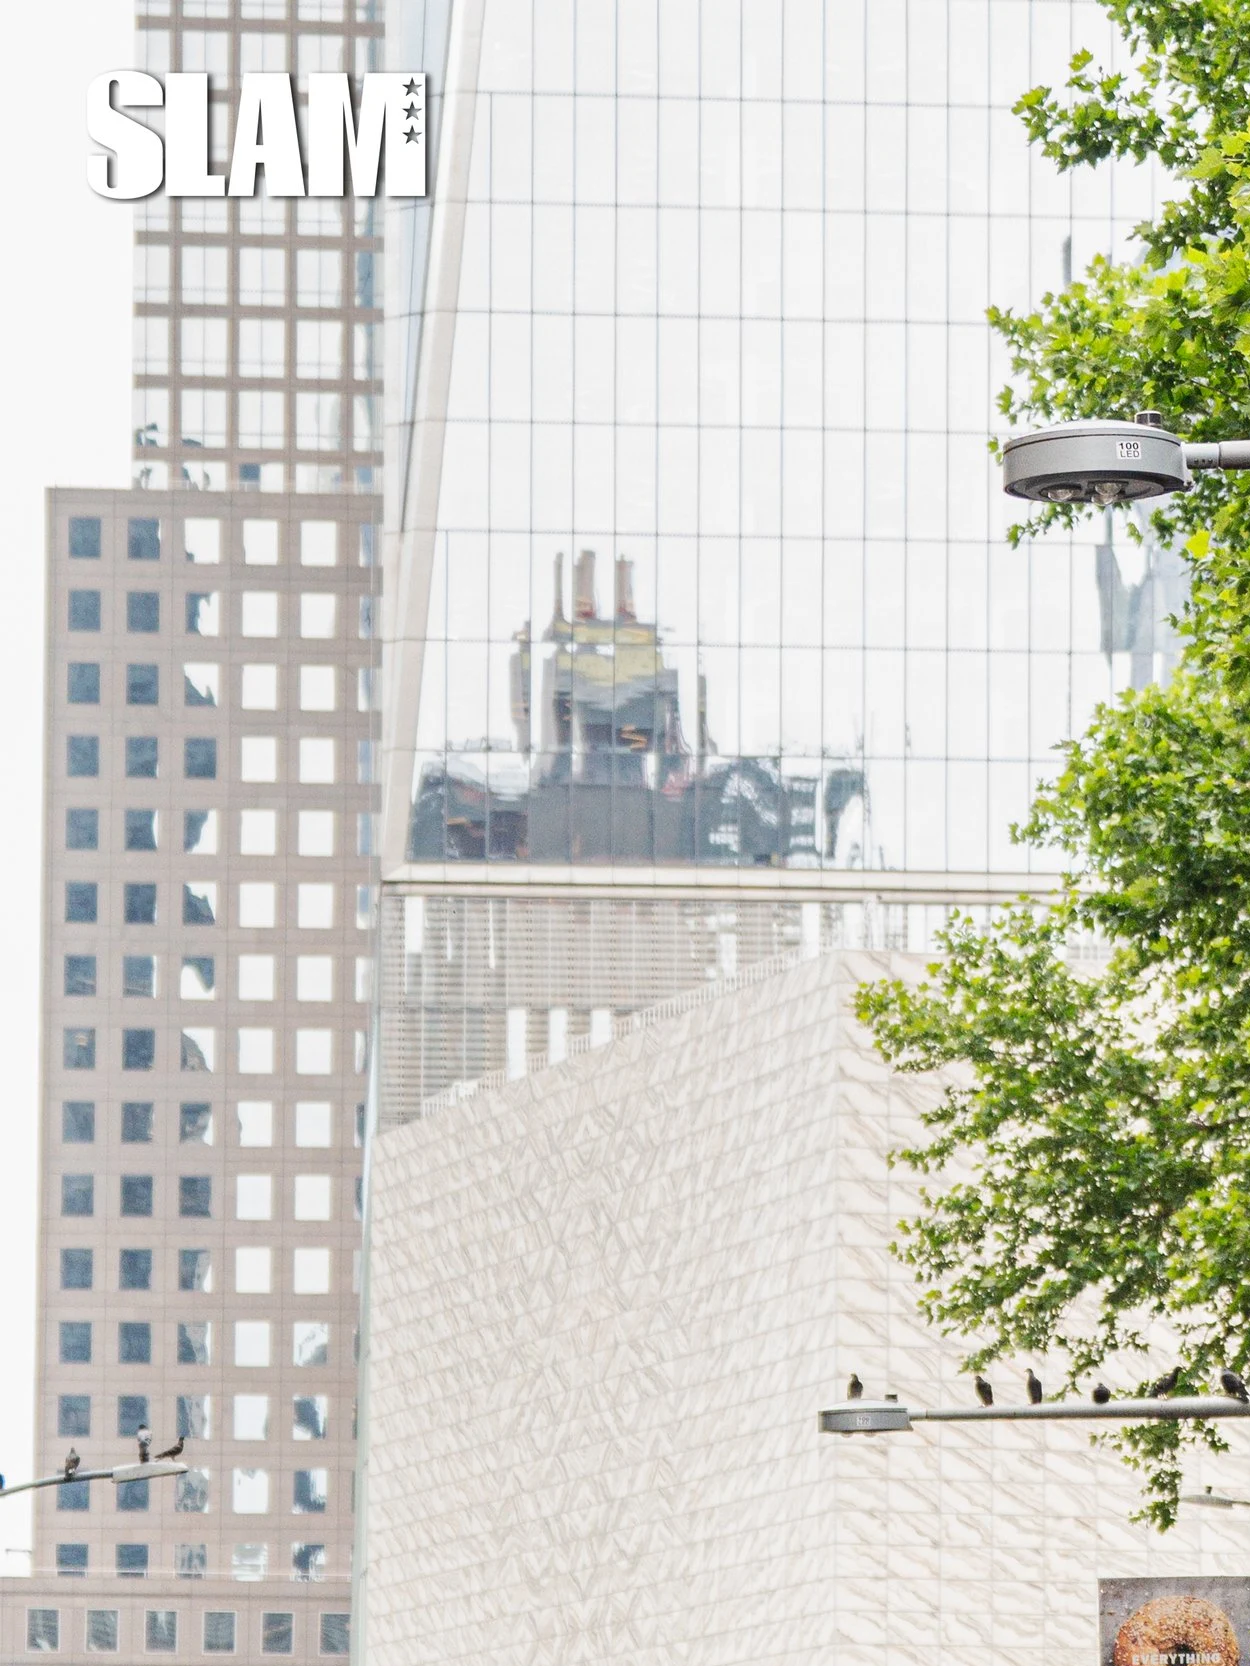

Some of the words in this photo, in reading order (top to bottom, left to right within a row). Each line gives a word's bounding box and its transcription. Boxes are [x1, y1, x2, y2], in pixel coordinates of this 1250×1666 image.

[1119, 442, 1139, 450] 100
[1120, 450, 1140, 458] LED
[1131, 1652, 1221, 1665] EVERYTHING
